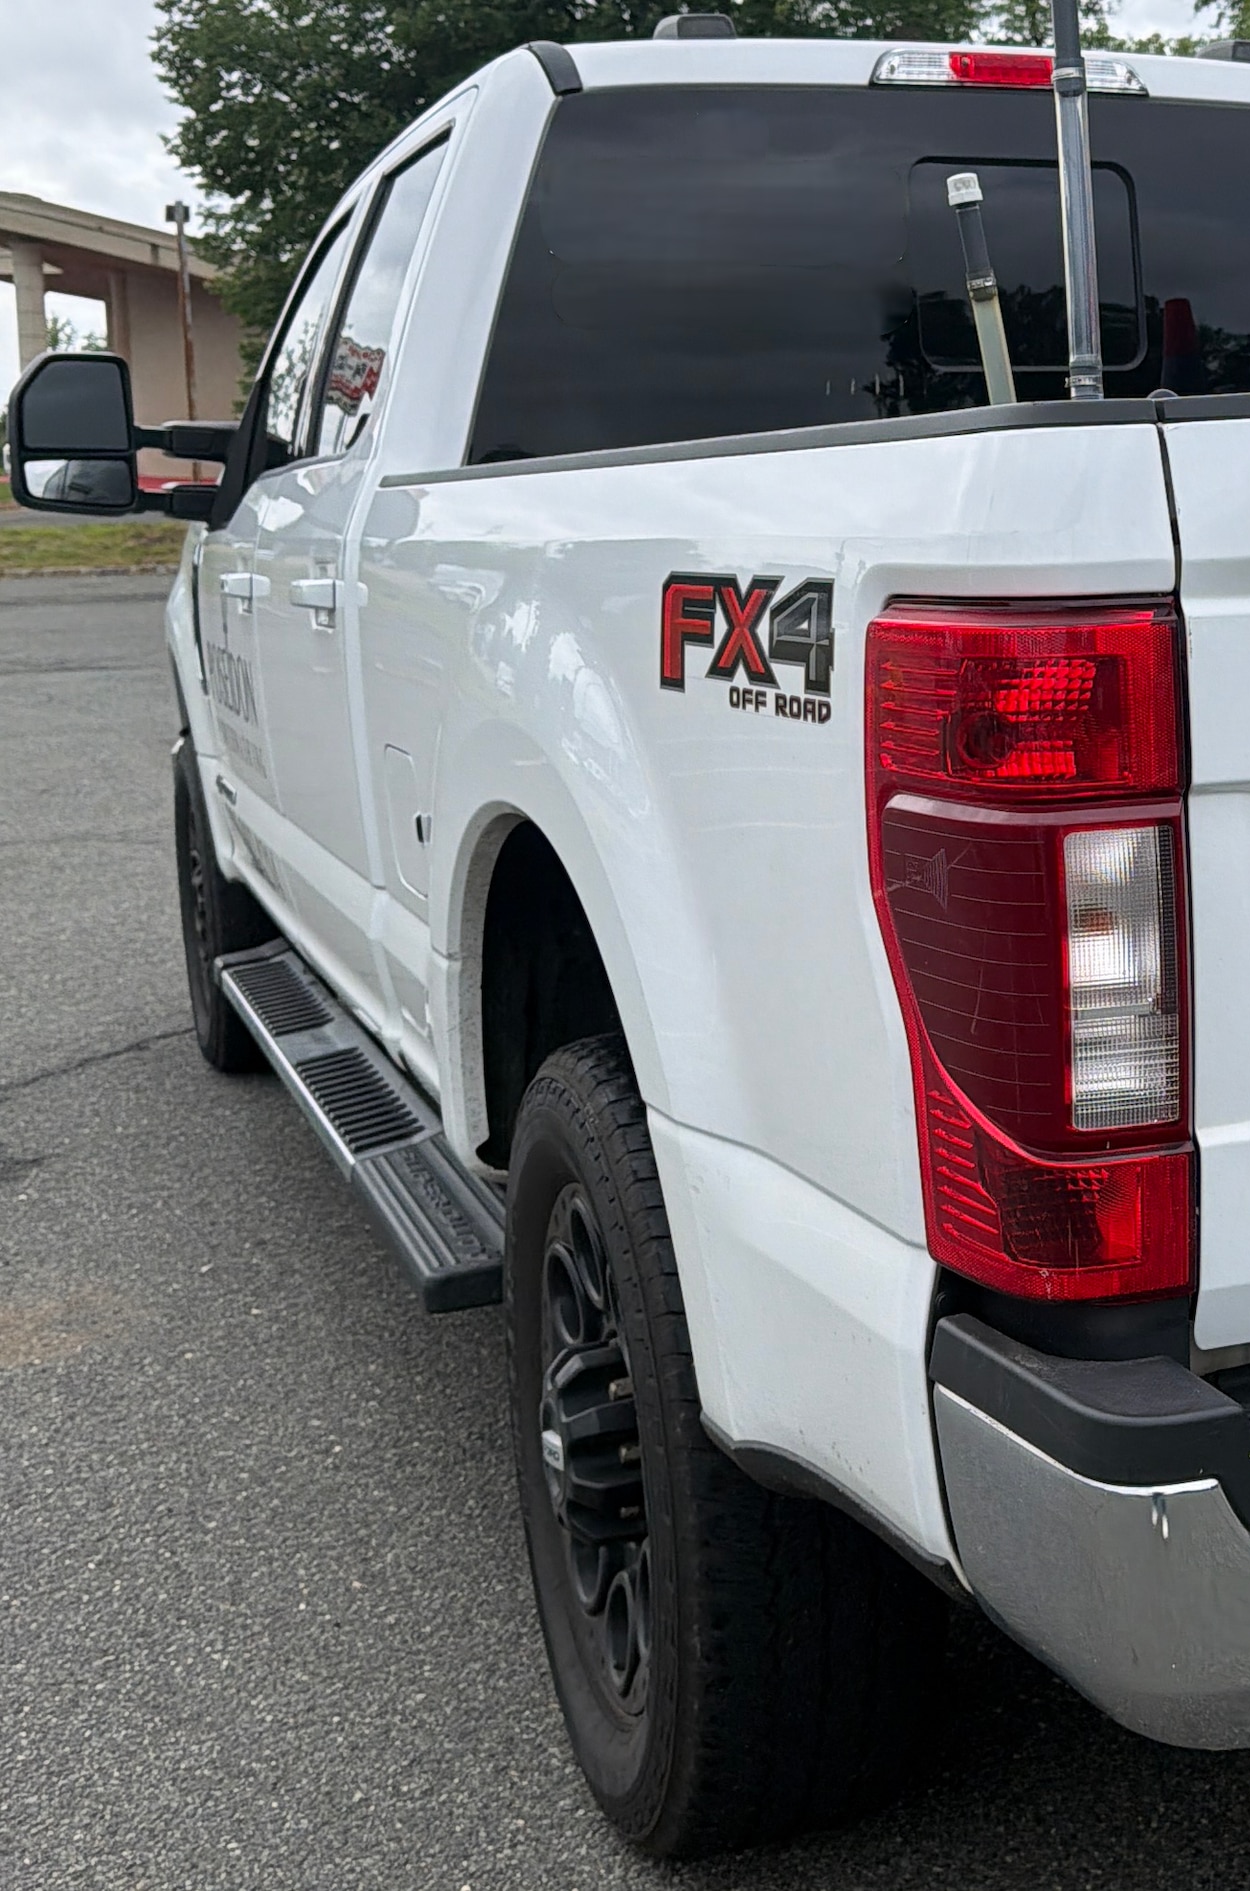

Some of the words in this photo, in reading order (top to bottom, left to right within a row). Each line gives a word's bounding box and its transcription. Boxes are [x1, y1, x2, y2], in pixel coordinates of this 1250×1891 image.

[660, 570, 835, 698] FX4
[729, 685, 767, 713] OFF
[774, 692, 832, 725] ROAD
